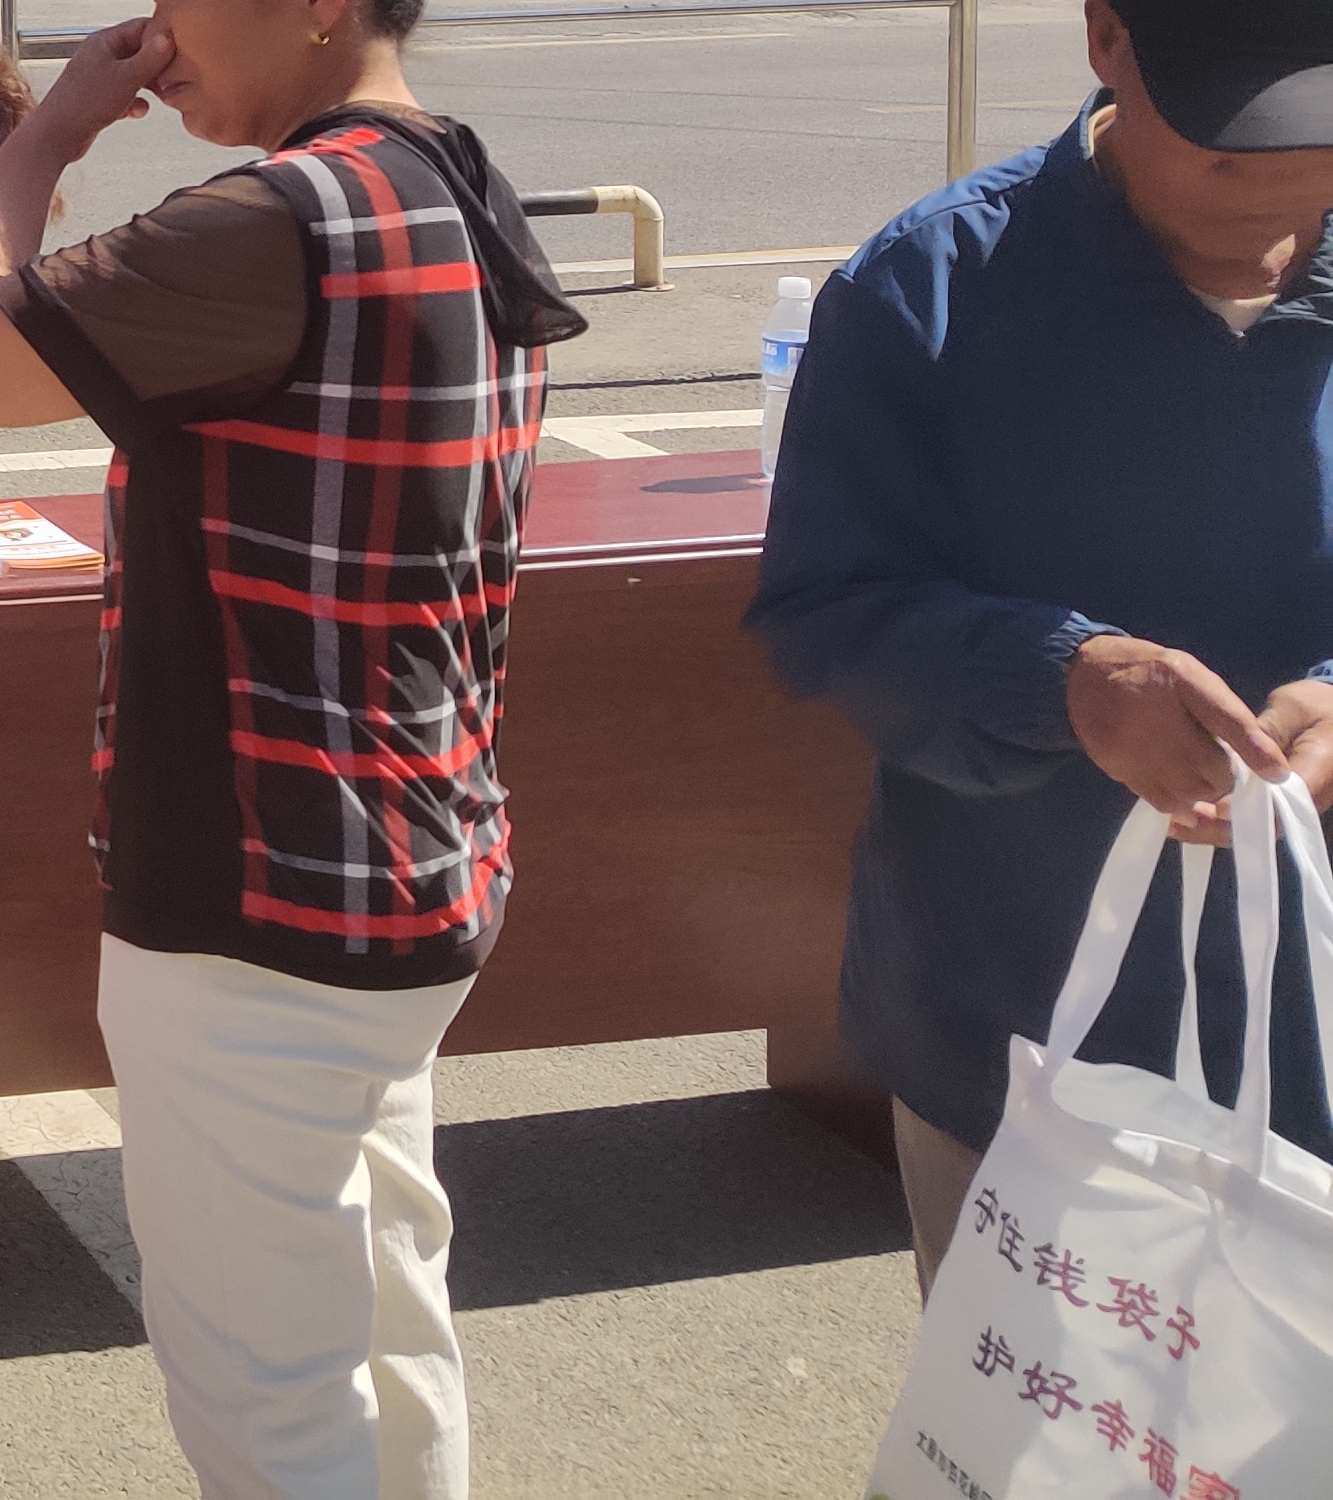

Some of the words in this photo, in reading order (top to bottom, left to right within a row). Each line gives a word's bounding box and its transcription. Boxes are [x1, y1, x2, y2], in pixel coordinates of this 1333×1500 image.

[974, 1186, 1201, 1361] 守住钱袋子
